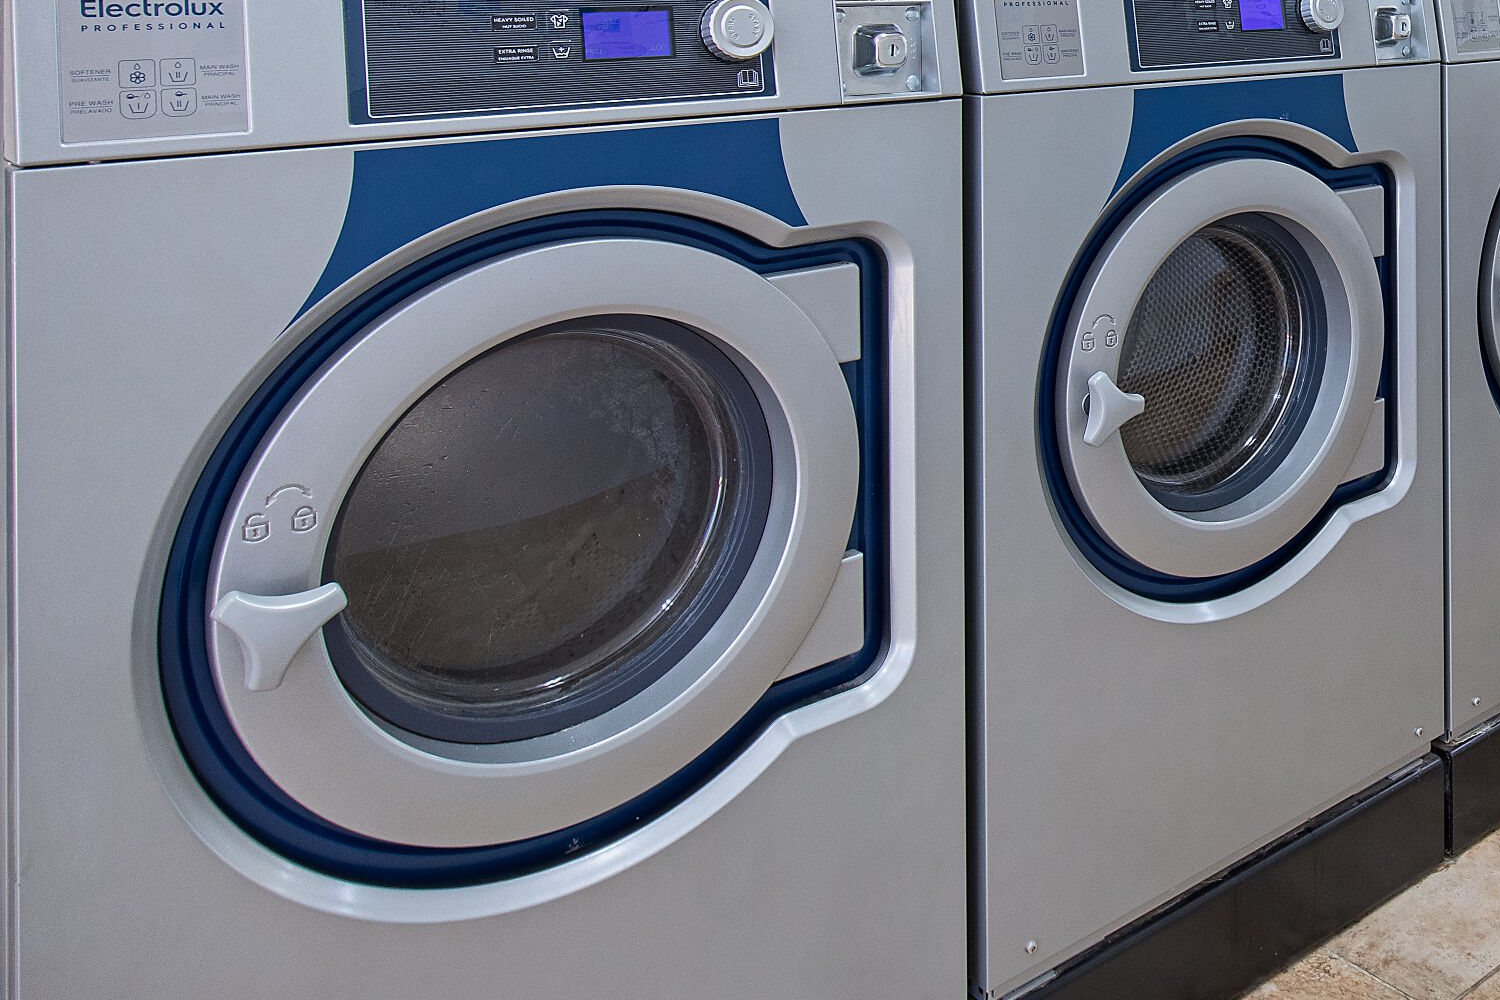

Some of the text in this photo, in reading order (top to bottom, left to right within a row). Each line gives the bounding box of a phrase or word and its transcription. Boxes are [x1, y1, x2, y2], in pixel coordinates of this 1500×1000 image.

[81, 22, 226, 32] PROFESSIONAL
[69, 68, 111, 77] SOFTENER
[91, 99, 114, 107] WASH
[70, 107, 112, 115] PRELAVADO
